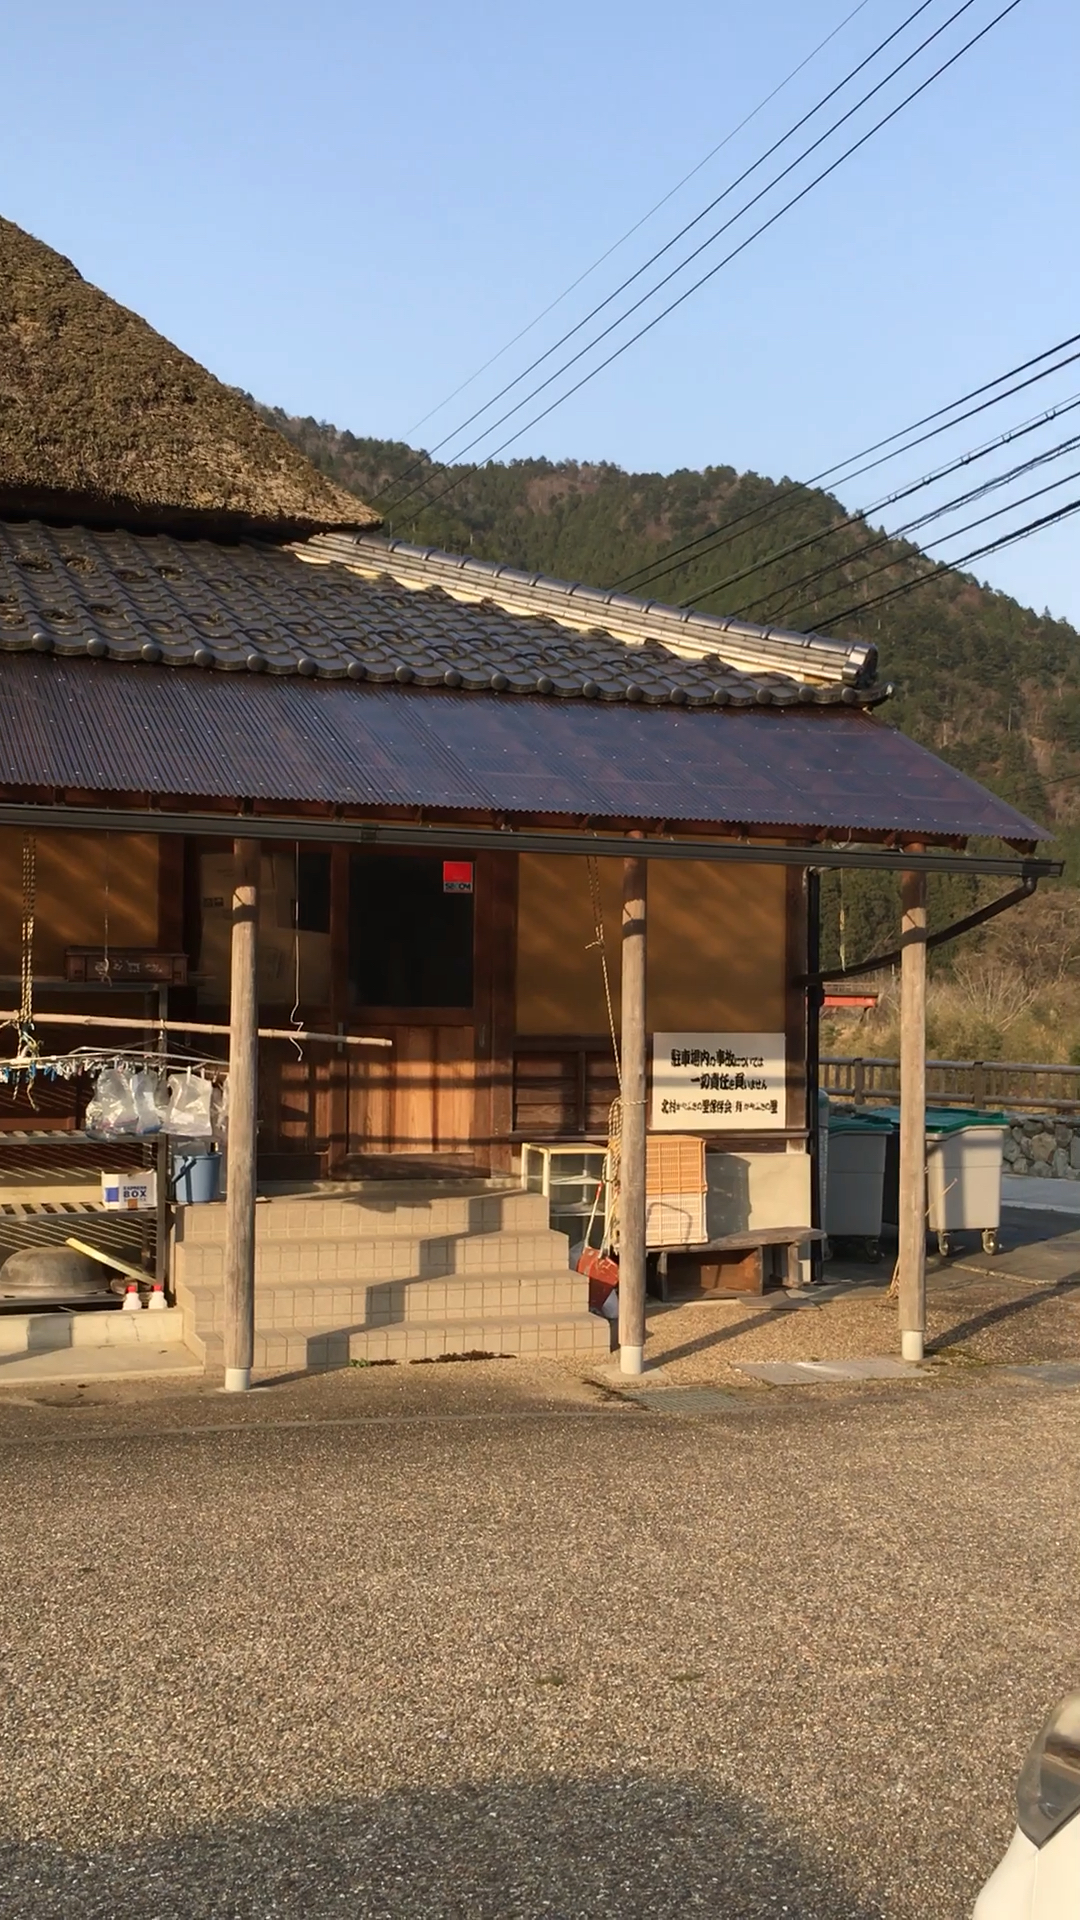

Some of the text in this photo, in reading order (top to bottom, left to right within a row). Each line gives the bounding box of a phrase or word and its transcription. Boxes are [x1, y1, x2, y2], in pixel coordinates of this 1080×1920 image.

[671, 1048, 764, 1068] 駐車場内の事故については
[690, 1072, 767, 1090] 一切責任を負いません
[123, 1190, 147, 1198] BOX
